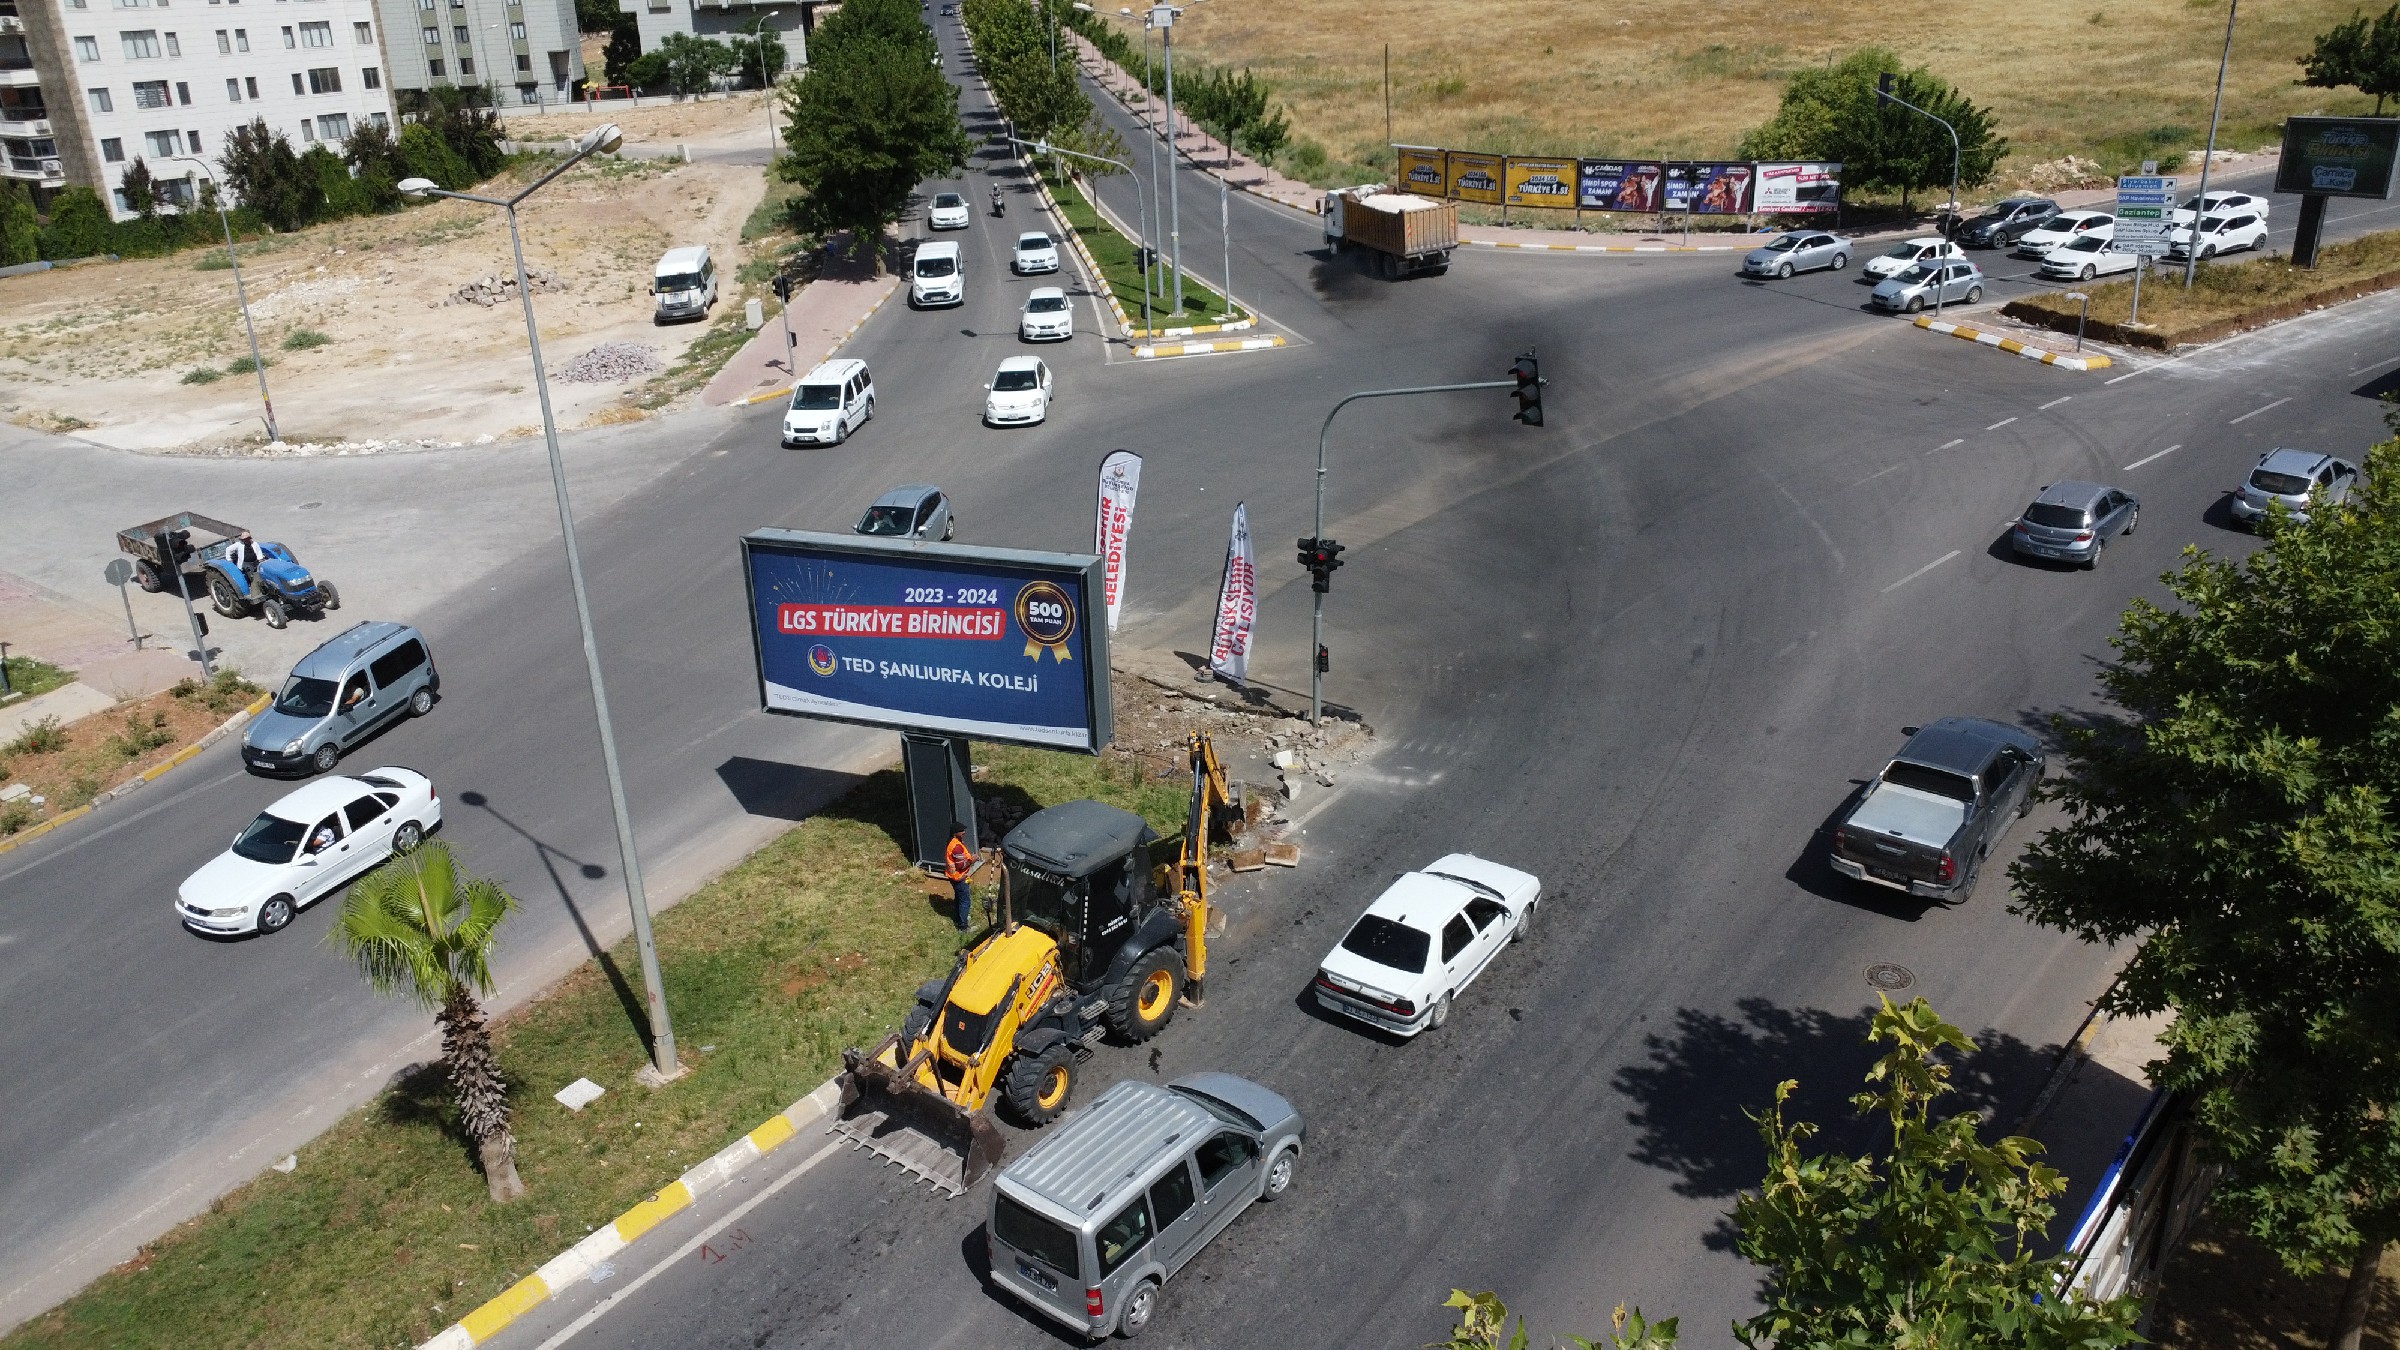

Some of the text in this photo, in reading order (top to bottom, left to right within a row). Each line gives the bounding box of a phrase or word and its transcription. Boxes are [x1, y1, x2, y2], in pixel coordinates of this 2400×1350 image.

[1518, 182, 1551, 194] TÜRKİYE
[2118, 208, 2161, 217] Gaziantep
[1105, 506, 1127, 606] BELEDİYESİ
[905, 587, 944, 603] 2023
[957, 589, 998, 605] 2024
[1029, 601, 1063, 618] 500
[783, 607, 1001, 636] LGS TÜRKİYE BİRİNCİSİ
[1030, 616, 1062, 626] TAM PUAN
[842, 656, 1038, 693] TED ŞANLIURFA KOLEJİ
[1025, 960, 1053, 1000] JCB
